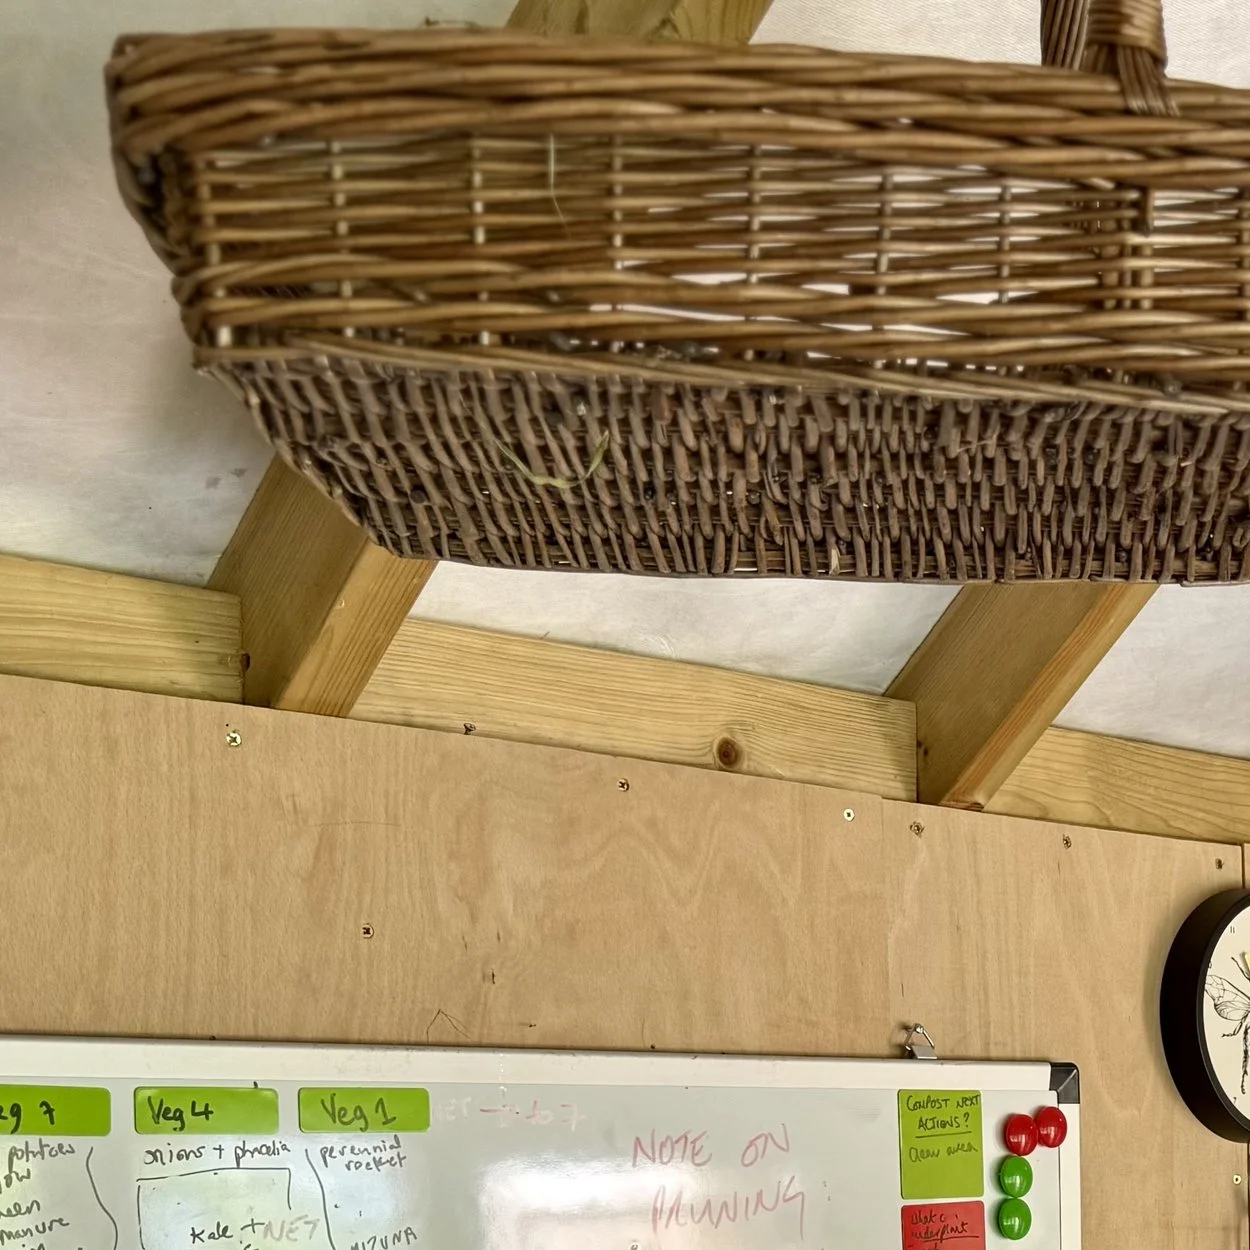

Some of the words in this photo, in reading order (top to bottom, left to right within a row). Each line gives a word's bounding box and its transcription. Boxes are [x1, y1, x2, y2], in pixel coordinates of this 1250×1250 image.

[0, 1103, 21, 1134] eg
[39, 1100, 55, 1125] 7
[147, 1095, 186, 1131] Veg
[191, 1100, 214, 1120] 4
[321, 1093, 369, 1132] Veg
[375, 1097, 397, 1126] 1
[632, 1128, 713, 1168] NOTE
[741, 1122, 790, 1168] ON
